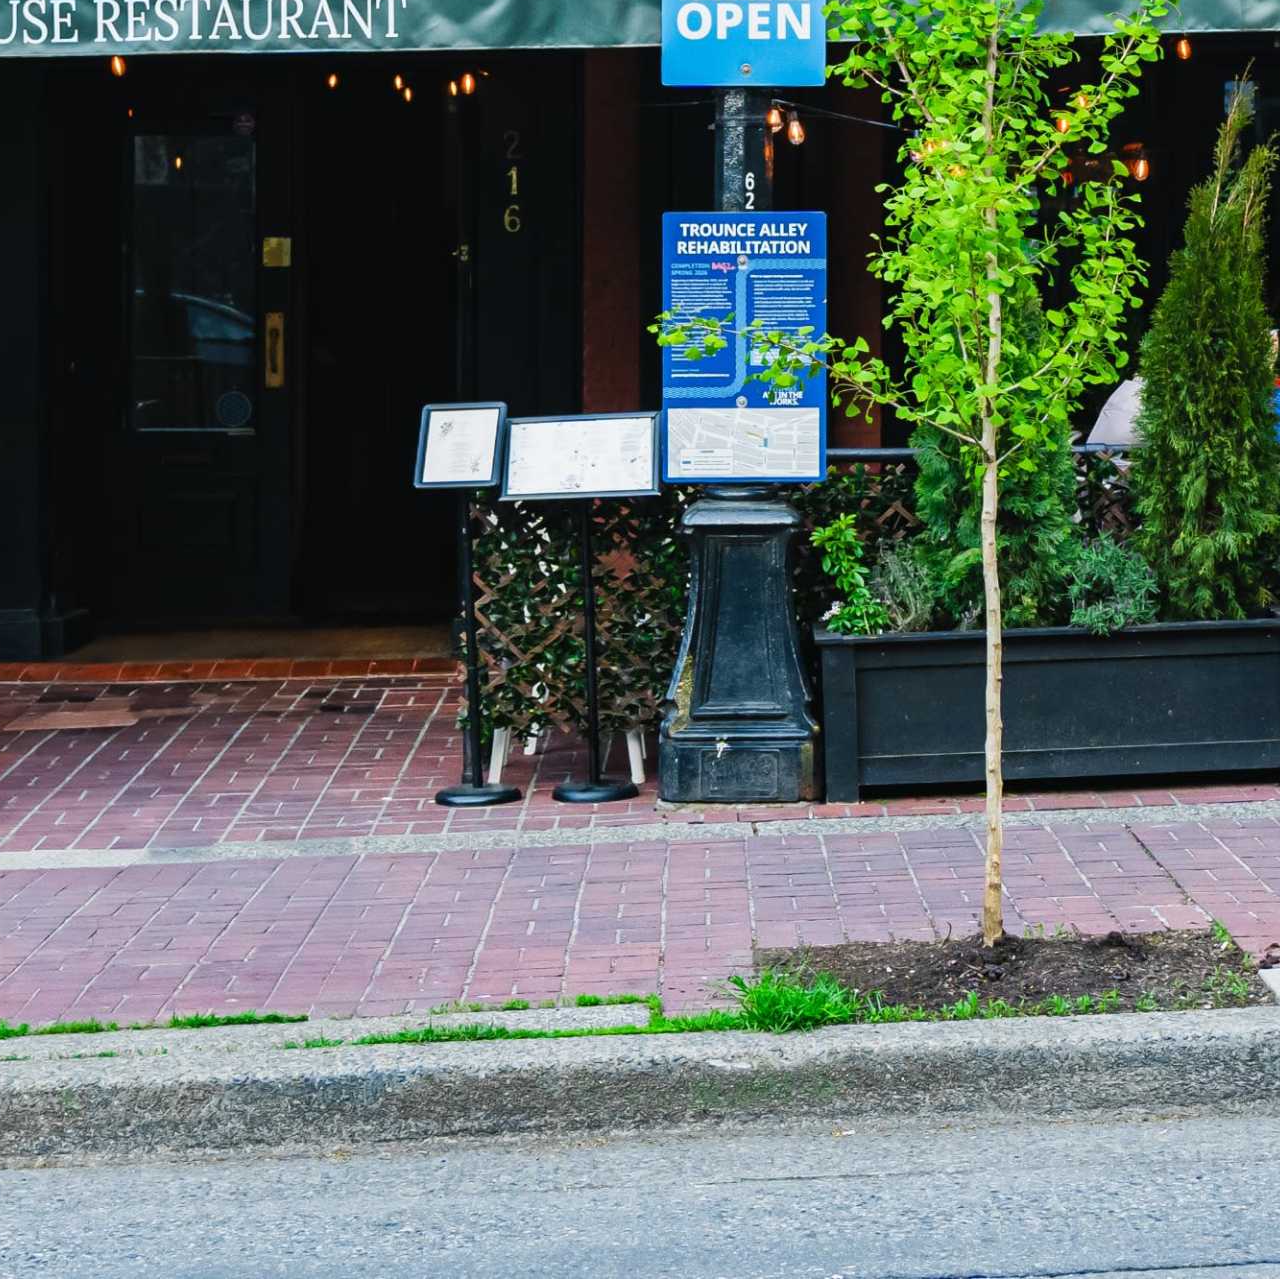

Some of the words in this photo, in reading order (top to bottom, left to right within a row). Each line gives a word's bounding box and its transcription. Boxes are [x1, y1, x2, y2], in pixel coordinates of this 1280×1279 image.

[676, 2, 812, 40] OPEN
[680, 223, 755, 237] TROUNCE
[759, 223, 807, 237] ALLEY
[677, 240, 811, 255] REHABILITATION
